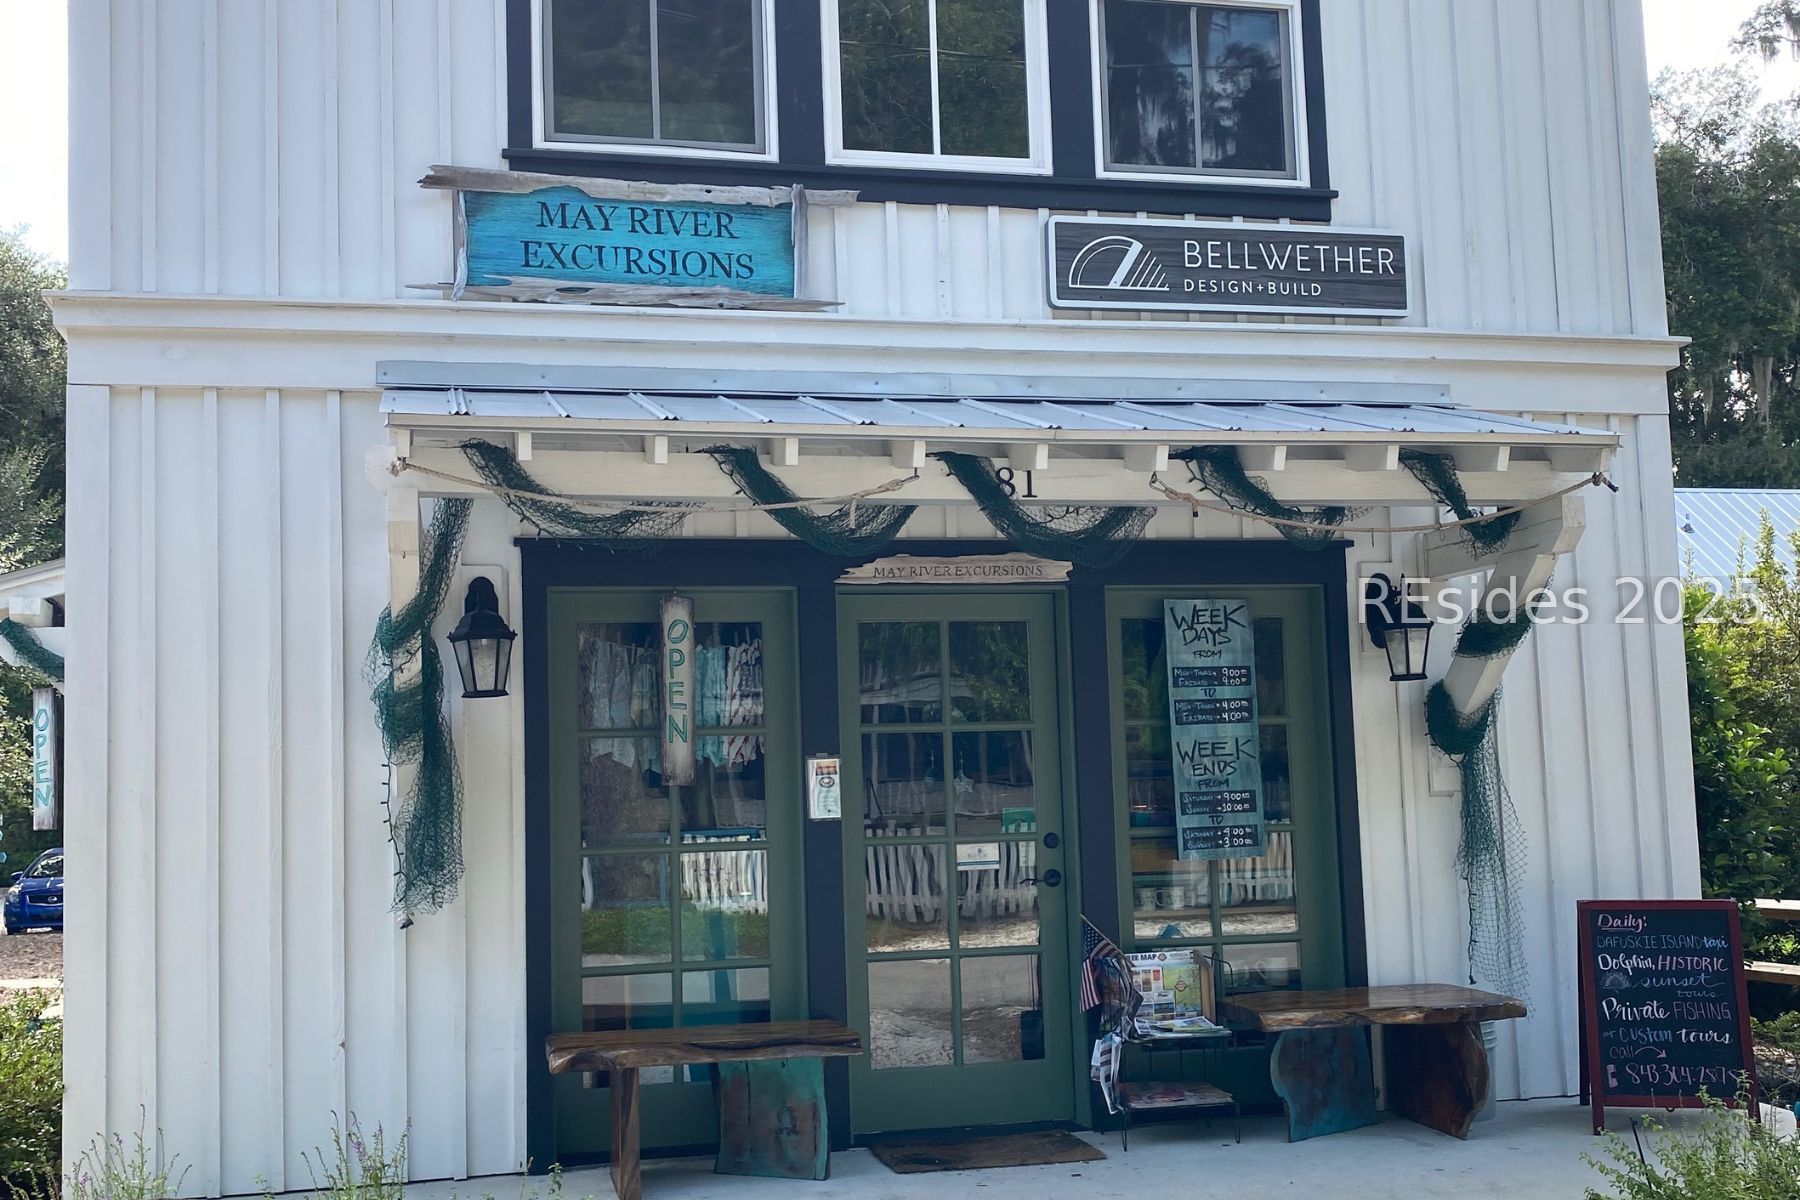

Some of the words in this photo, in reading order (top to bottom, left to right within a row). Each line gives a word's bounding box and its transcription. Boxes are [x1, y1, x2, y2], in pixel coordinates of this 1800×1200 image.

[536, 200, 620, 233] MAY
[628, 206, 740, 240] RIVER
[520, 240, 755, 280] EXCURSIONS
[1184, 240, 1396, 276] BELLWETHER
[1184, 279, 1322, 297] DESIGN+BUILD
[997, 467, 1038, 499] 81
[873, 566, 907, 578] MAY
[910, 566, 950, 577] RIVER
[954, 565, 1043, 577] EXCURSIONS
[1169, 604, 1247, 630] WEEK
[1181, 627, 1232, 647] DAYS
[1192, 650, 1223, 660] FROM
[667, 618, 690, 744] OPEN
[1200, 687, 1217, 698] TO
[34, 708, 52, 808] OPEN
[1176, 737, 1256, 765] WEEK
[1192, 760, 1237, 777] ENDS
[1198, 778, 1230, 790] FROM
[1209, 815, 1224, 825] TO
[1597, 913, 1647, 933] Daily:
[1596, 935, 1659, 949] DAFUSKIE
[1660, 934, 1703, 949] ISLAND
[1703, 934, 1729, 950] taxi
[1141, 953, 1157, 961] MAP
[1657, 955, 1728, 973] HISTORIC
[1633, 974, 1724, 989] sunset
[1602, 997, 1670, 1021] Private
[1673, 1001, 1732, 1021] FISHING
[1676, 1028, 1734, 1045] tours
